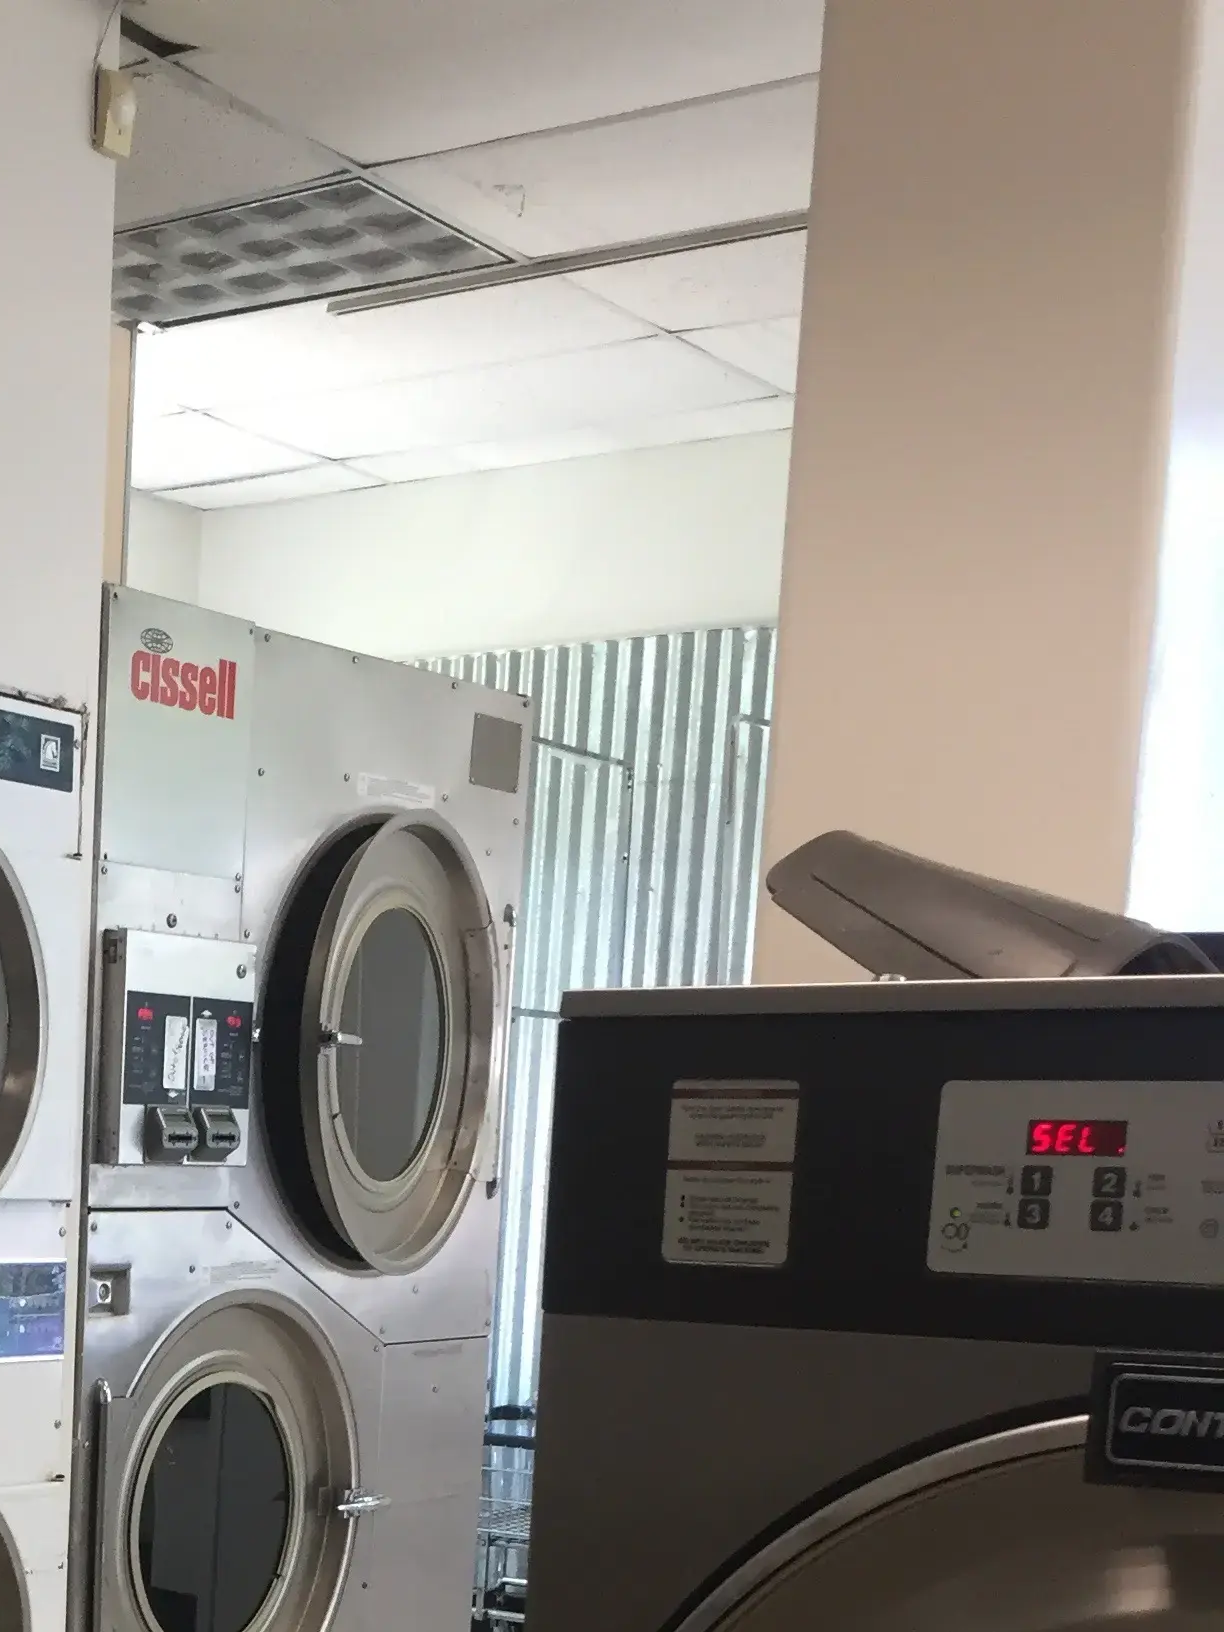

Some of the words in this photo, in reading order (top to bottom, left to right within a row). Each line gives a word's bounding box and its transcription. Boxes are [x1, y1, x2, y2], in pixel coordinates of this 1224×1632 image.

[1032, 1171, 1042, 1192] 1
[1100, 1172, 1118, 1193] 2
[1026, 1203, 1042, 1224] 3
[1097, 1206, 1114, 1226] 4
